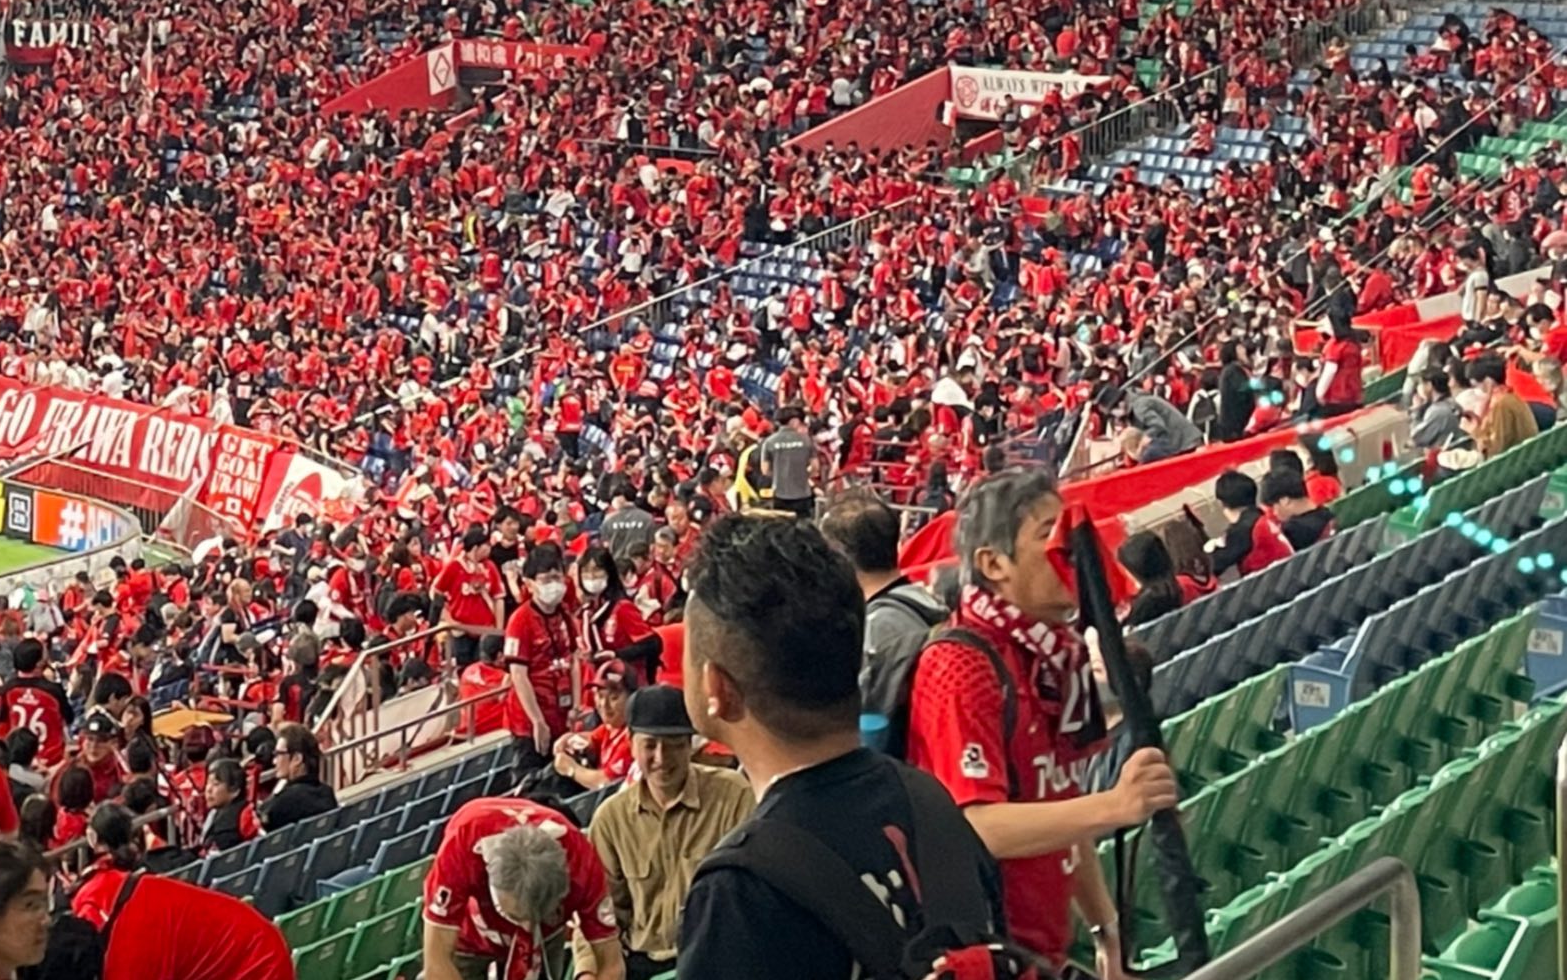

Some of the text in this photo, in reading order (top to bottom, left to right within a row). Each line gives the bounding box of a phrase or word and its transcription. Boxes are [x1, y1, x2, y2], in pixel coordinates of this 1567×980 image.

[35, 397, 139, 469] URAWA
[139, 415, 220, 486] REDS
[221, 432, 274, 463] GET
